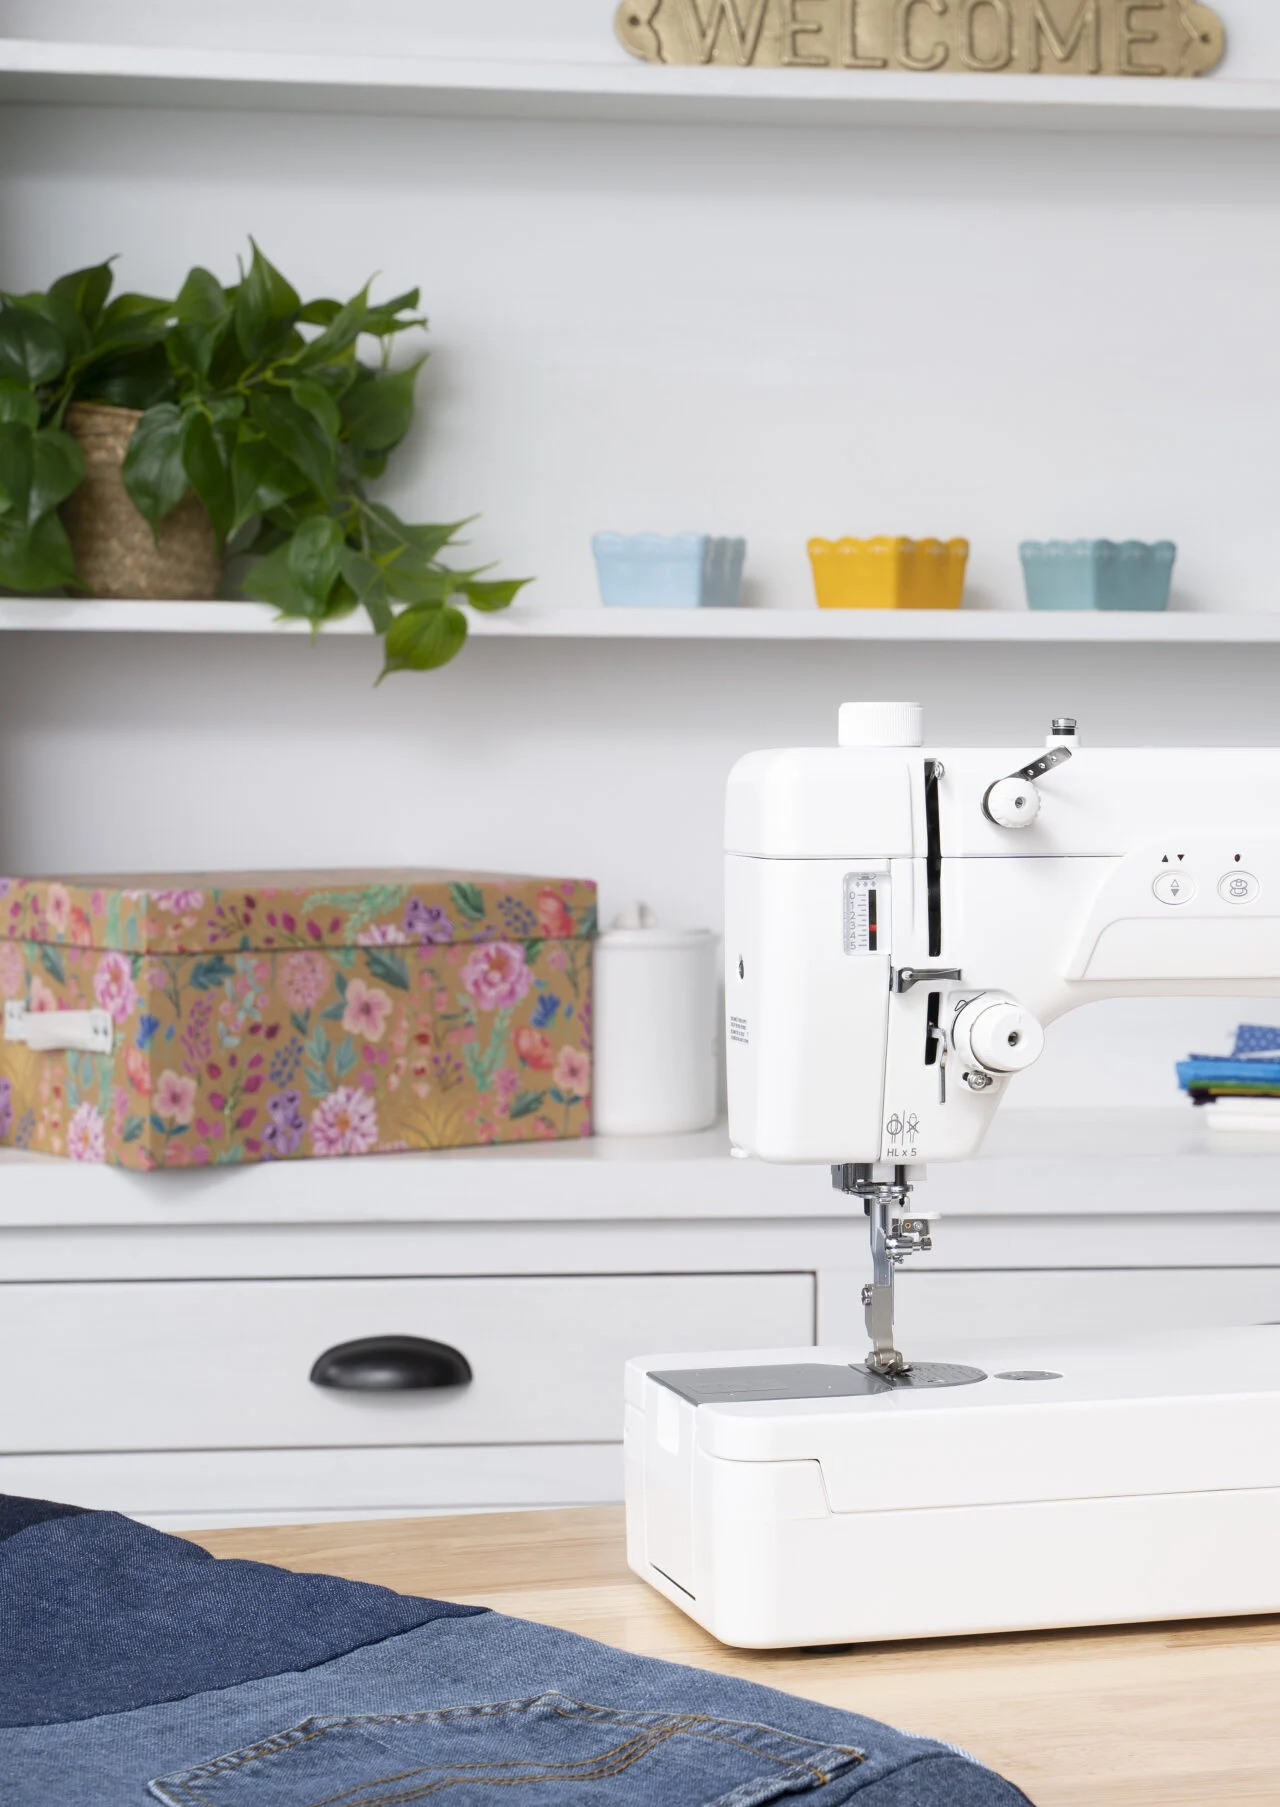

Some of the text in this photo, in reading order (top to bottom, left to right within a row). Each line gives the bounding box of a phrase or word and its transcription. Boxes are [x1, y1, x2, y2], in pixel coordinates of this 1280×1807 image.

[681, 0, 1167, 76] WELCOME
[849, 891, 856, 900] 0
[849, 911, 856, 920] 2
[849, 921, 856, 930] 3
[849, 931, 856, 940] 4
[850, 941, 857, 950] 5
[886, 1147, 900, 1157] HL
[910, 1147, 917, 1157] 5
